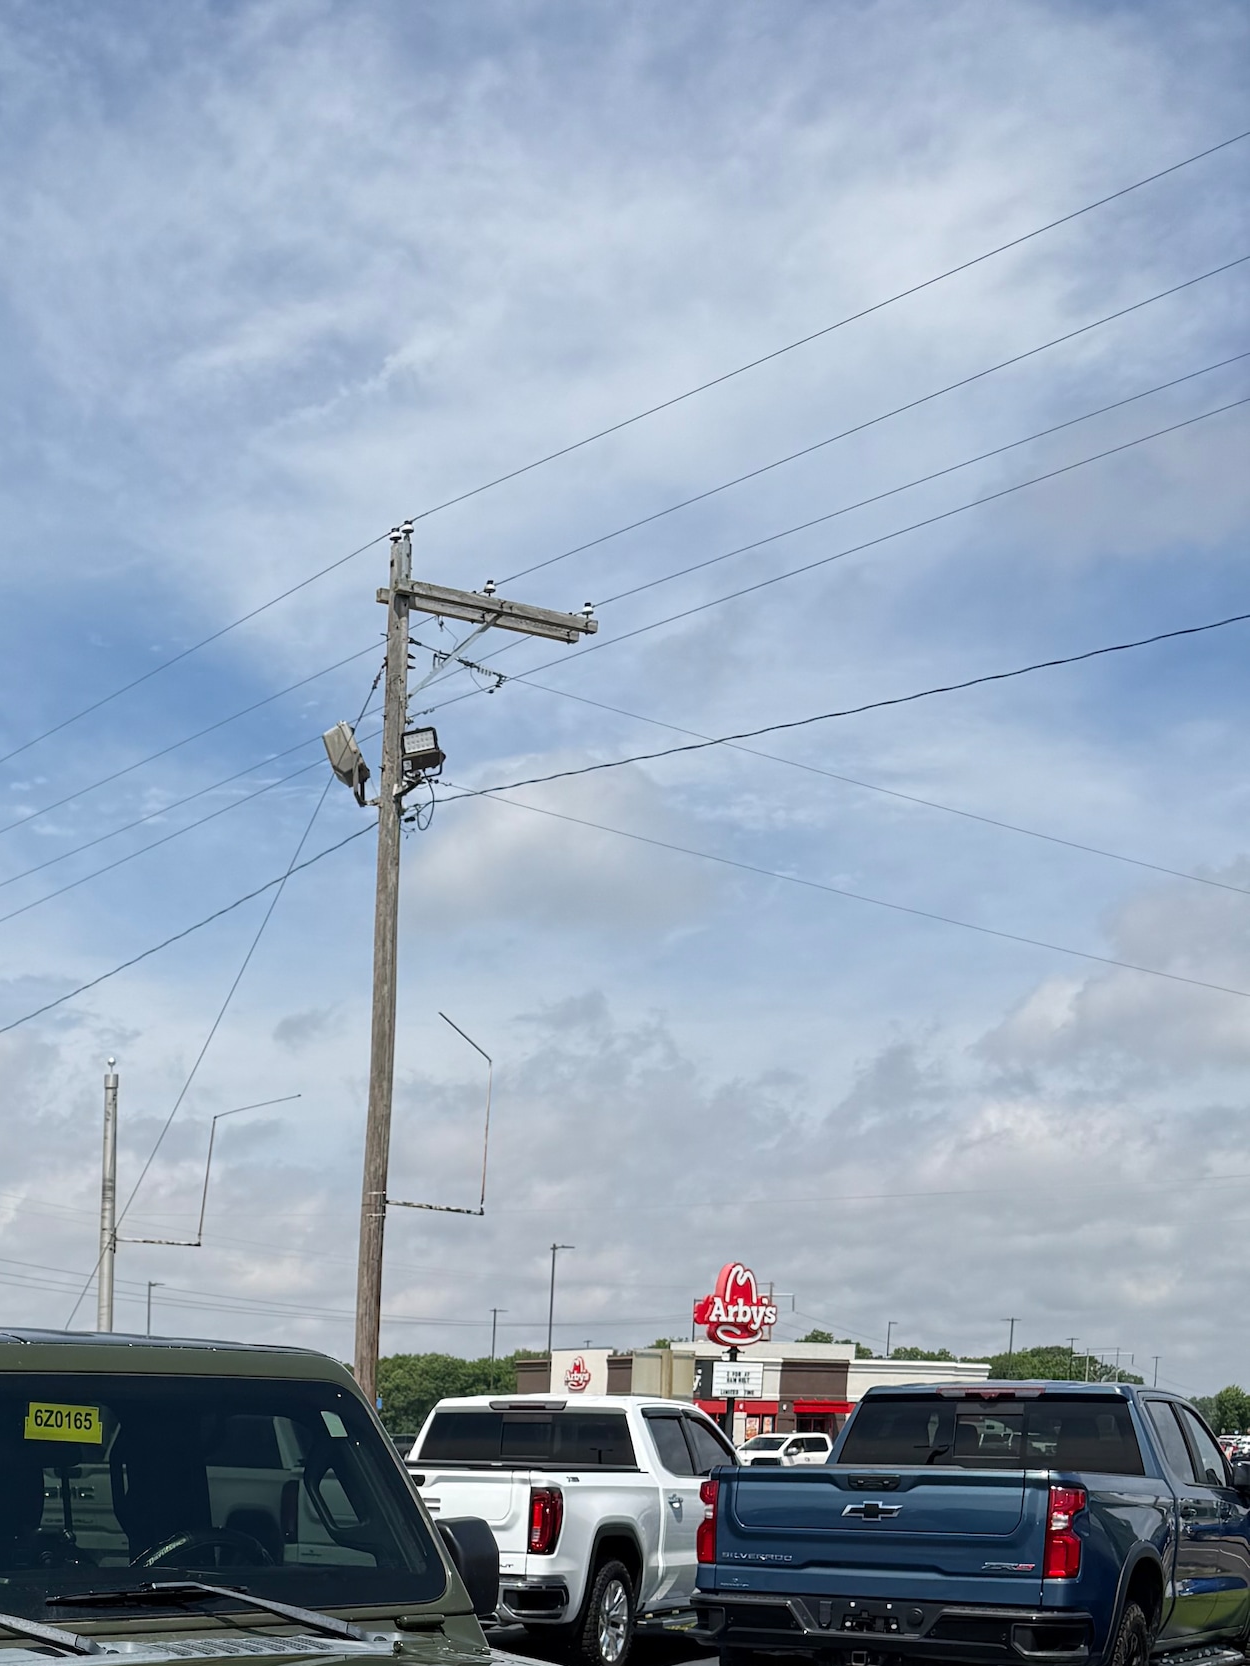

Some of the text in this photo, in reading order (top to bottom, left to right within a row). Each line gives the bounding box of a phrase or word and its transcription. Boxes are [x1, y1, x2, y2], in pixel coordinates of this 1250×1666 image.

[709, 1296, 777, 1331] Arby's
[34, 1409, 92, 1430] 6Z0165
[722, 1551, 793, 1561] SILVERADO
